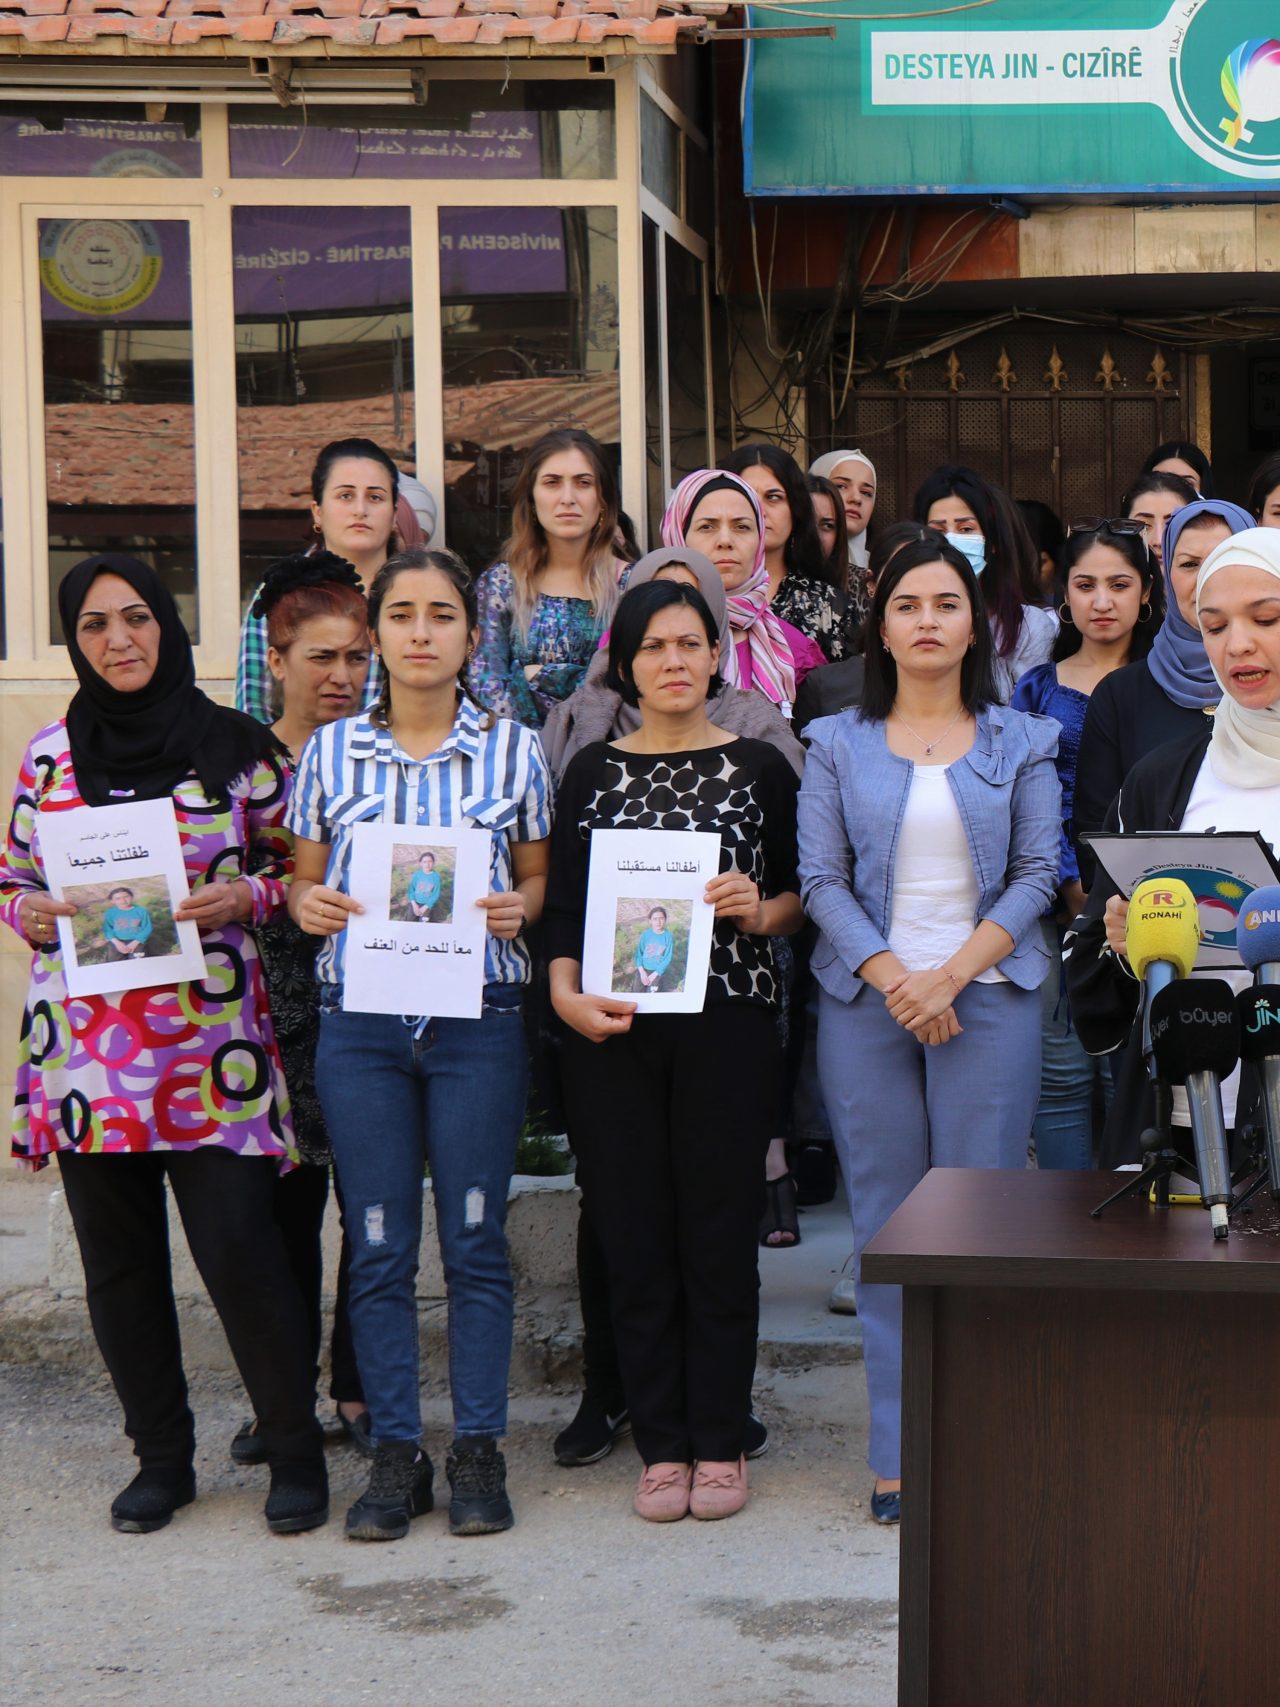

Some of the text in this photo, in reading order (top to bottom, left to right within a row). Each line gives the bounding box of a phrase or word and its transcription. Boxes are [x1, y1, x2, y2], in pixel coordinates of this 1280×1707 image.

[884, 53, 995, 80] DESTEYA
[1001, 53, 1038, 79] JIN
[1062, 46, 1143, 78] CIZÎRÊ
[110, 844, 150, 862] طفلتنا
[616, 858, 662, 875] مستقبلنا
[363, 937, 397, 951] العنف
[401, 942, 420, 955] من
[425, 941, 449, 954] للحد
